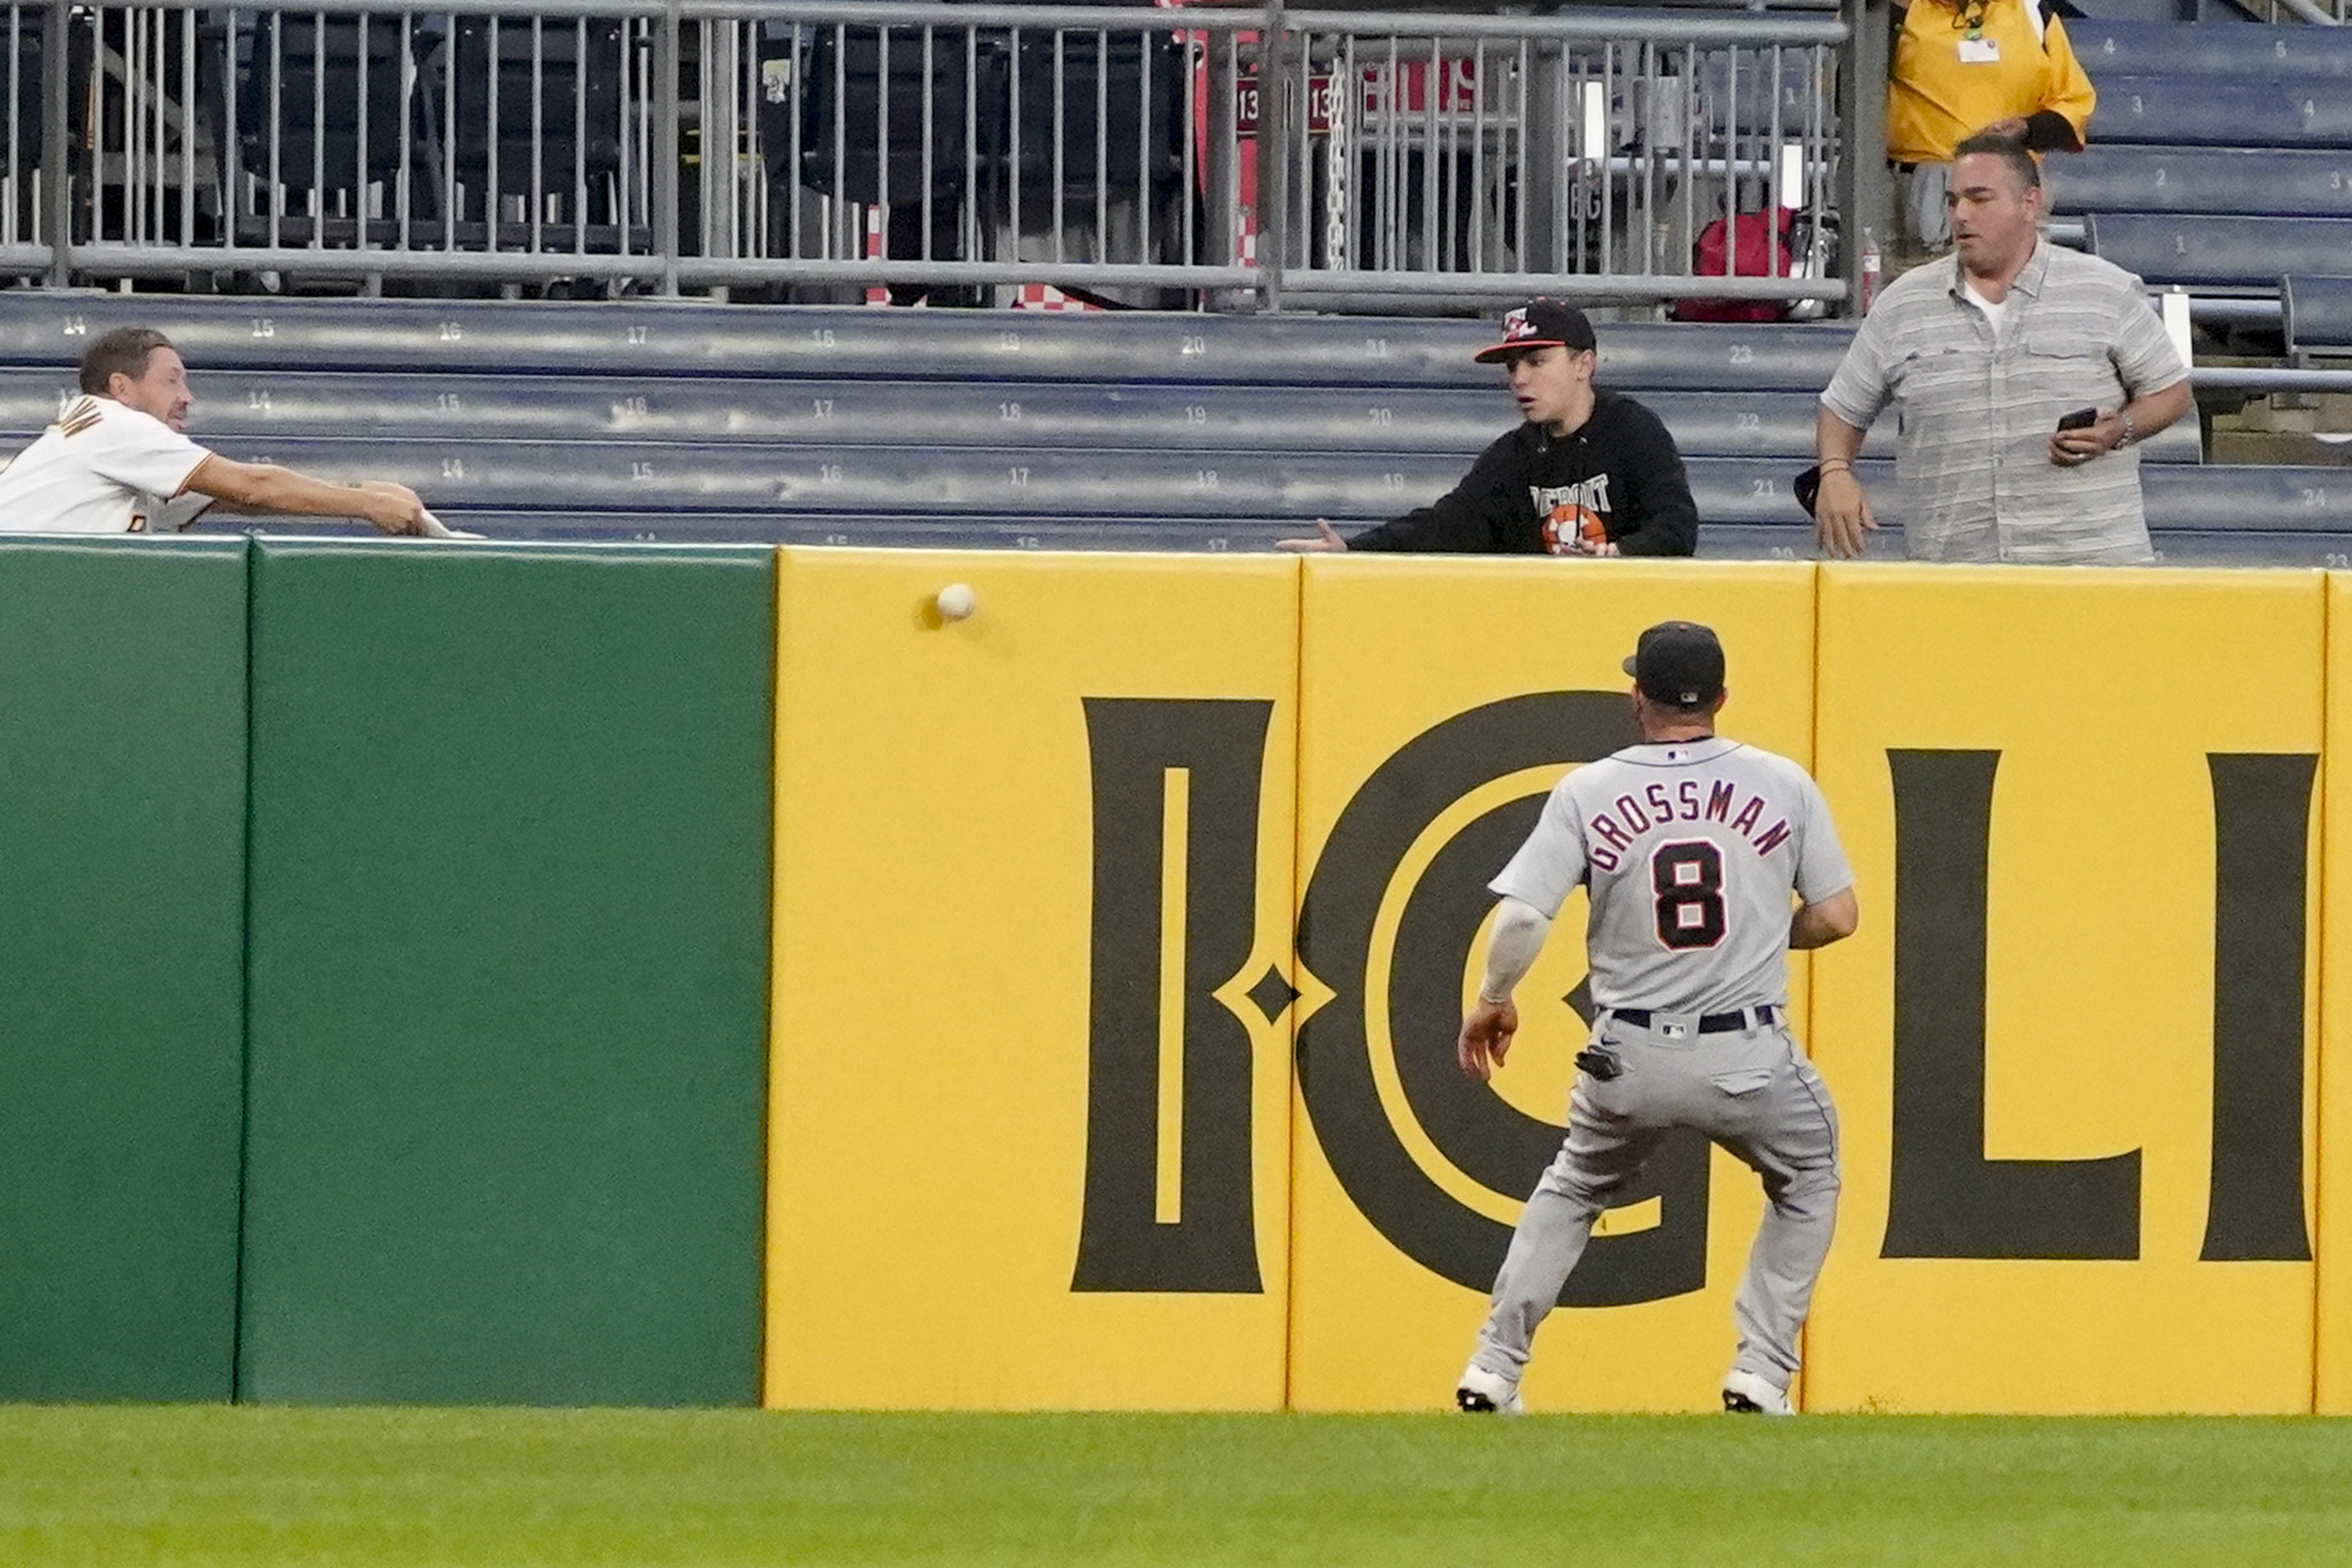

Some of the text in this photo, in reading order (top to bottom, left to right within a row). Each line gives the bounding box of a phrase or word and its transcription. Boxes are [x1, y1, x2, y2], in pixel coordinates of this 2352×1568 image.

[2104, 38, 2116, 55] 4
[2132, 95, 2143, 114] 3
[2303, 100, 2315, 117] 4
[2155, 169, 2167, 187] 2
[2329, 170, 2341, 190] 3
[2175, 235, 2187, 253] 1
[64, 317, 86, 336] 14
[252, 320, 274, 339] 15
[626, 326, 648, 344] 17
[1182, 336, 1206, 355] 20
[1729, 345, 1753, 363] 23
[249, 391, 271, 409] 14
[438, 393, 460, 411] 15
[813, 399, 833, 417] 17
[999, 401, 1022, 420] 18
[1185, 405, 1207, 424] 19
[1737, 412, 1761, 430] 22
[441, 459, 464, 478] 14
[1010, 467, 1030, 486] 17
[1754, 478, 1775, 496] 21
[2303, 488, 2326, 507] 24
[1588, 779, 1792, 873] GROSSMAN
[1650, 837, 1730, 953] 8
